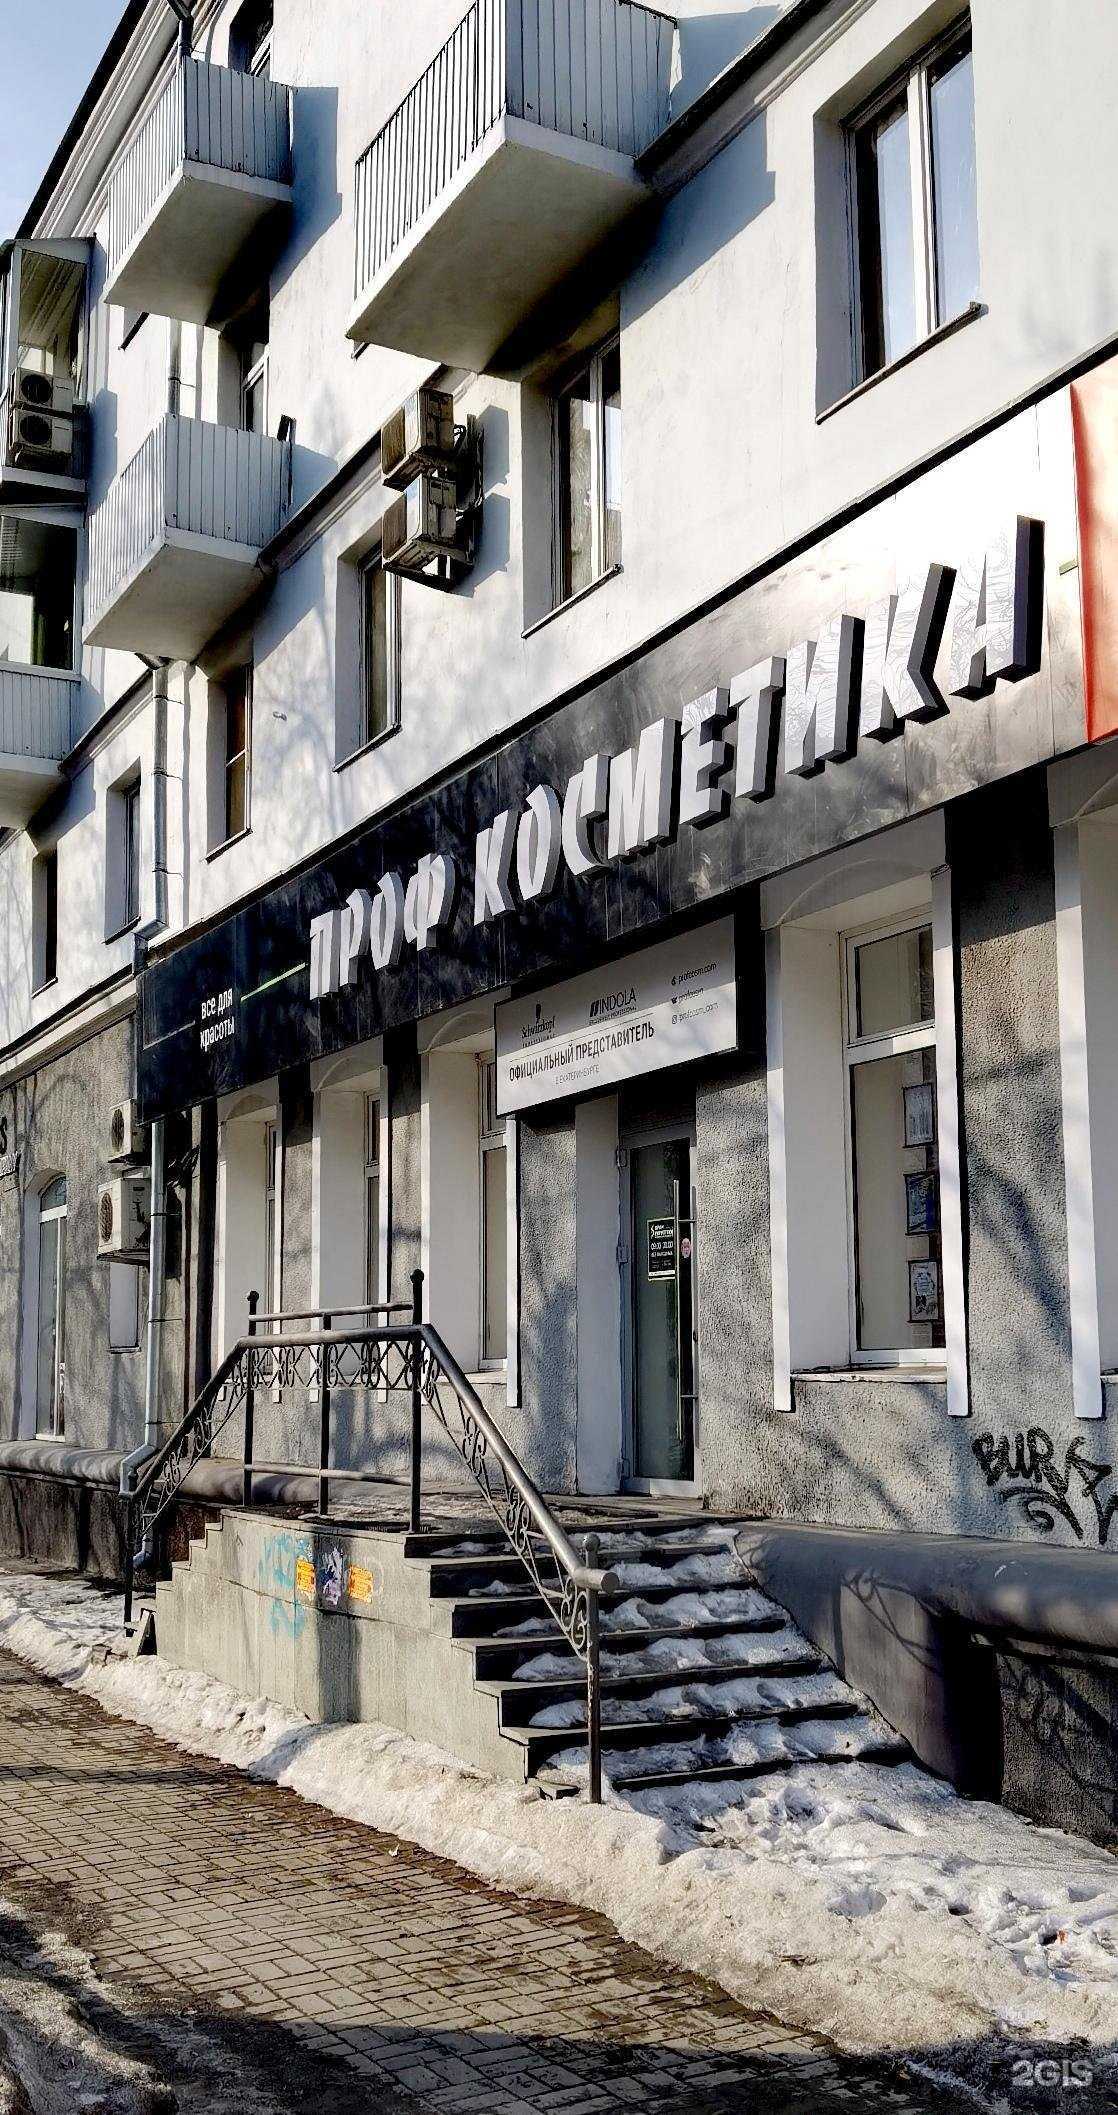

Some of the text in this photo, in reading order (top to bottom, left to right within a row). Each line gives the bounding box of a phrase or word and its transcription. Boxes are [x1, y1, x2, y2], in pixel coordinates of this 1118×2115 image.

[310, 514, 1045, 1001] ПРОФ КОСМЕТИКА
[201, 988, 233, 1020] все для
[598, 987, 637, 1015] INDOLA
[200, 1016, 235, 1052] красоты
[509, 1043, 575, 1083] ОФИЦИАЛЬНЫЙ
[575, 1021, 655, 1060] ПРЕДСТАВИТЕЛЬ
